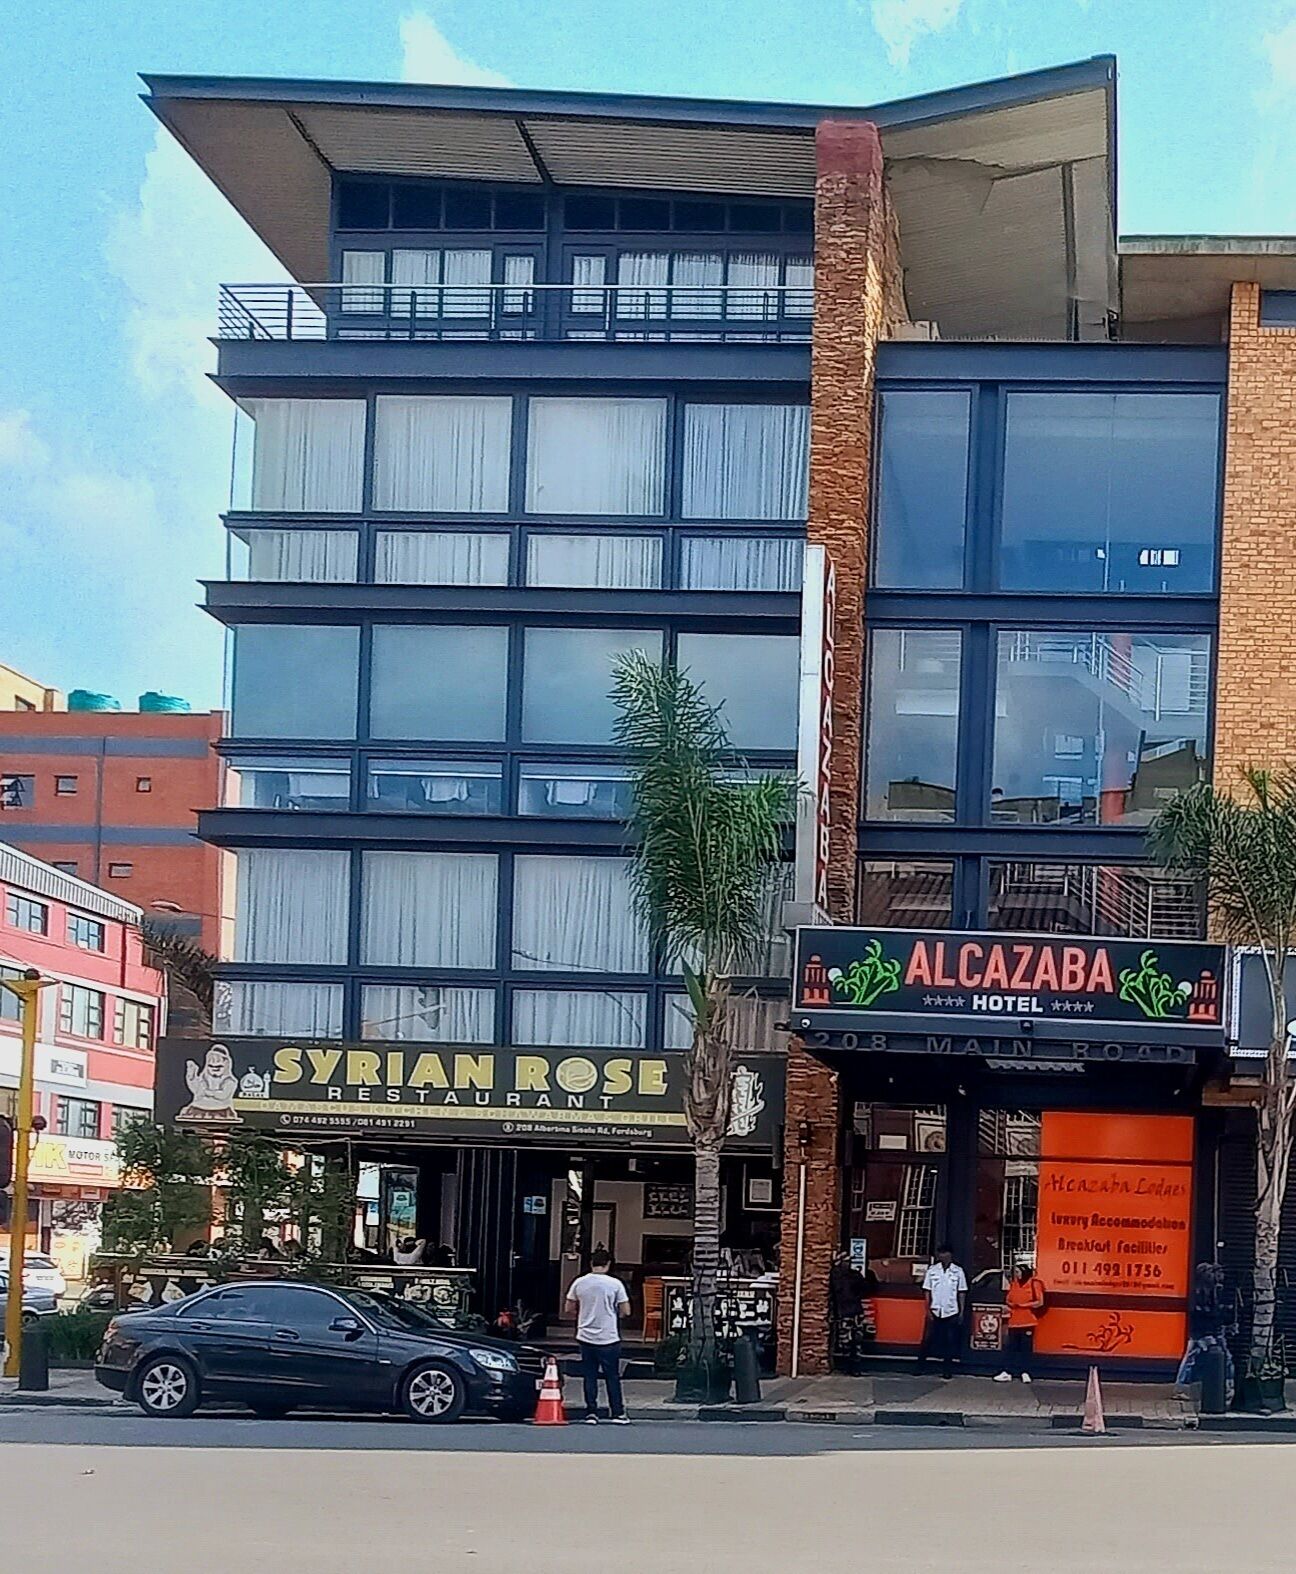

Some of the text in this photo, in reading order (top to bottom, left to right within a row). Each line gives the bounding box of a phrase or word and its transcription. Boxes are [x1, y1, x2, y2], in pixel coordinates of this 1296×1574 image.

[904, 940, 1115, 993] ALCAZABA
[972, 994, 1043, 1013] HOTEL
[813, 1031, 1187, 1063] 208 MAIN ROAD
[273, 1047, 668, 1095] SYRIAN ROSE
[328, 1087, 614, 1109] RESTAURANT
[259, 1101, 362, 1114] DAMASCUS
[293, 1116, 309, 1124] 074
[69, 1150, 101, 1161] MOTOR
[1044, 1173, 1186, 1200] Alcazaba Lodges
[1051, 1212, 1186, 1230] Luxury Accommodation
[1058, 1237, 1111, 1252] Breakfast
[1062, 1261, 1162, 1277] 011 492 1756
